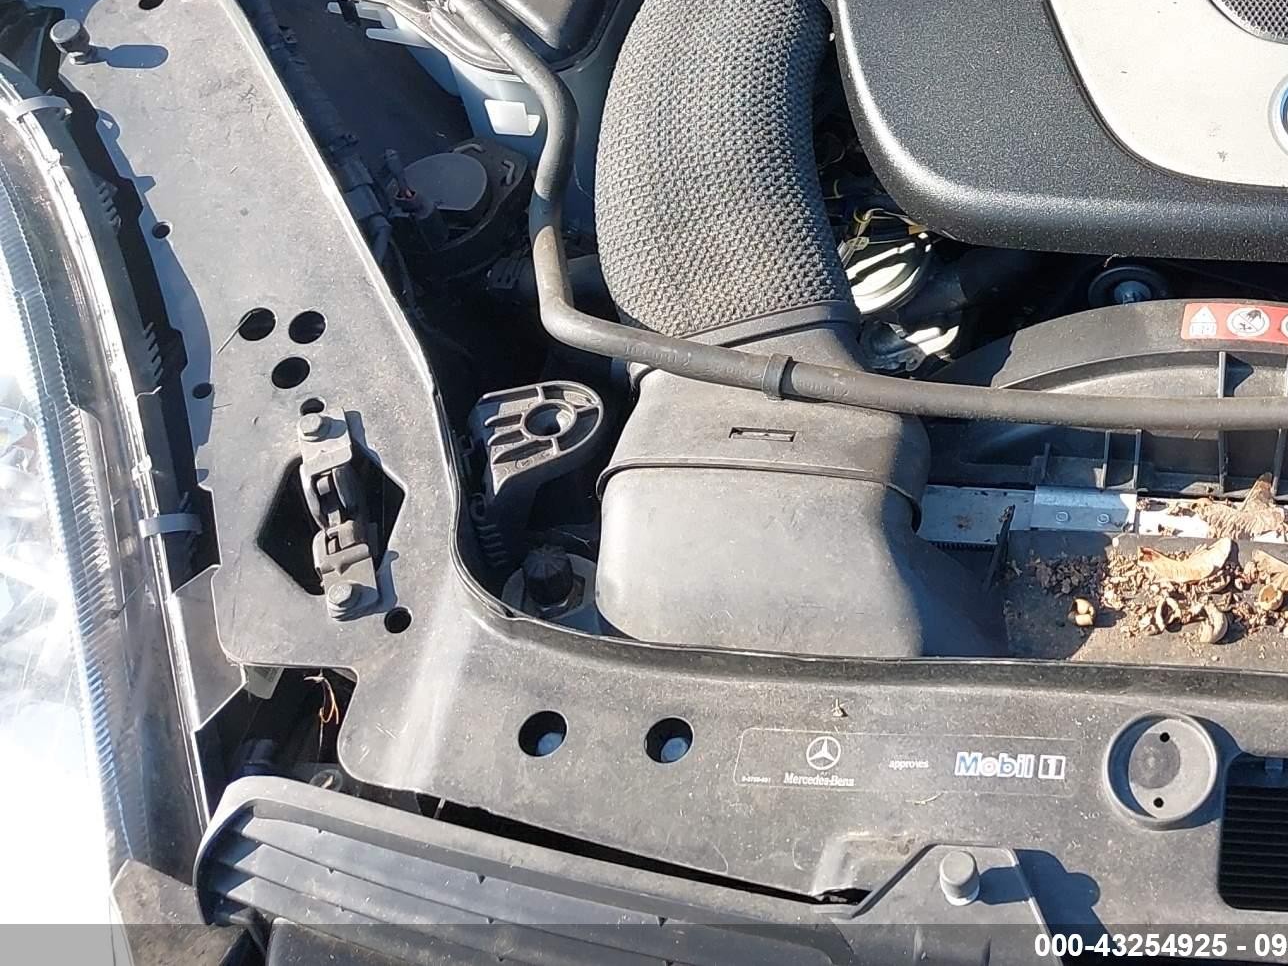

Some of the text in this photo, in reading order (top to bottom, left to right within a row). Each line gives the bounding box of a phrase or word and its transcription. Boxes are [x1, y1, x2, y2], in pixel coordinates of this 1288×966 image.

[889, 751, 1066, 780] approves Mobil 1
[783, 772, 855, 787] Mercedes-Benz
